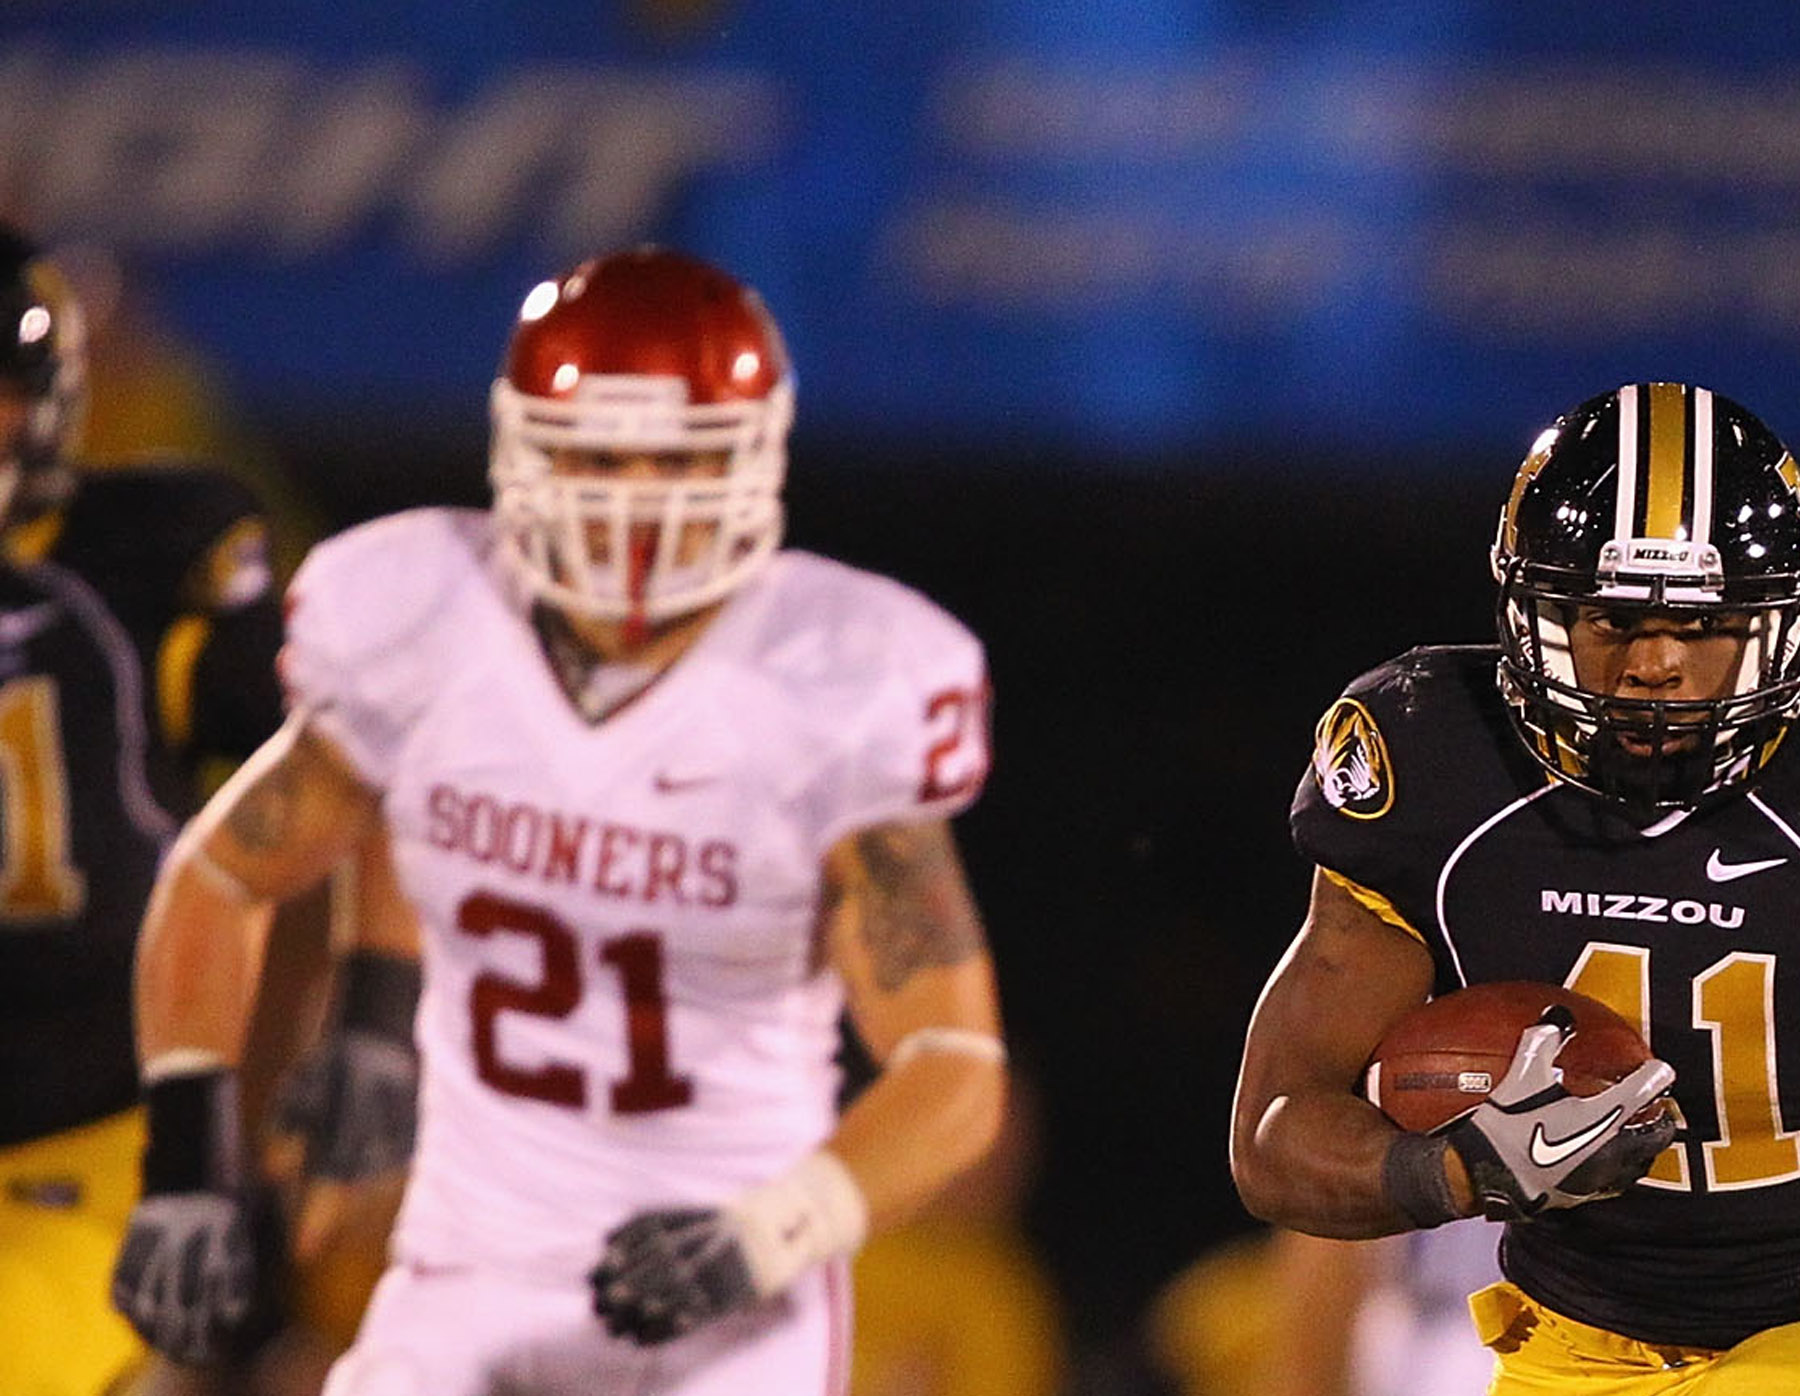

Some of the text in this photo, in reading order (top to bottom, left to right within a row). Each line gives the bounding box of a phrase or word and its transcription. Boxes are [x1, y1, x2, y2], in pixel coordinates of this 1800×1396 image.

[427, 783, 739, 908] SOONERS
[1541, 890, 1745, 929] MIZZOU
[456, 889, 696, 1117] 21
